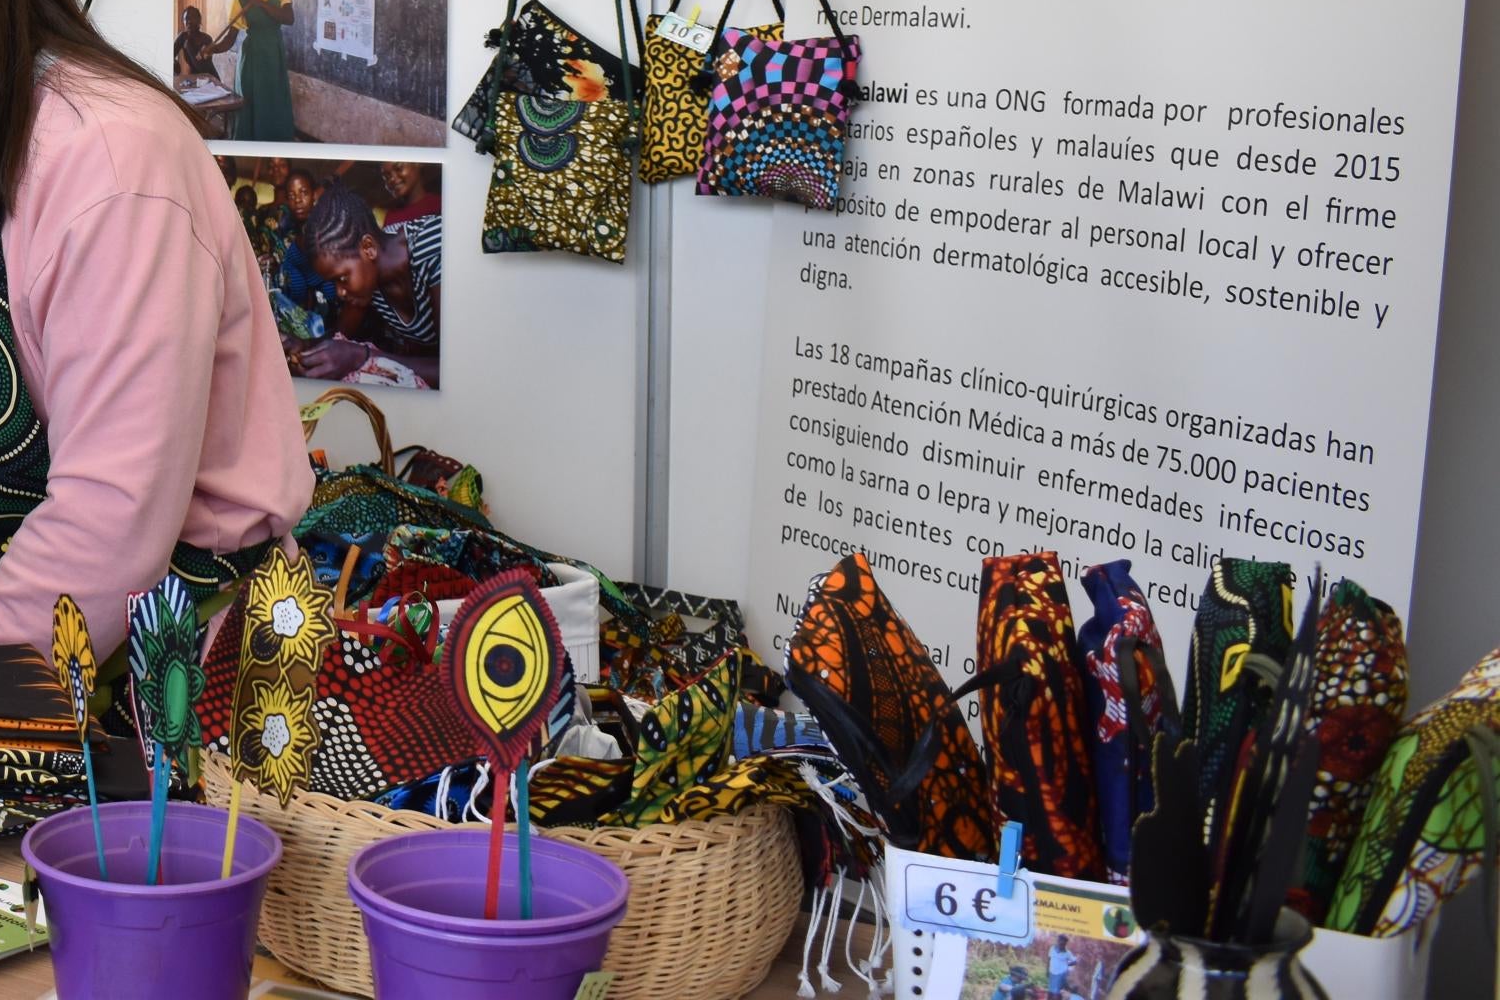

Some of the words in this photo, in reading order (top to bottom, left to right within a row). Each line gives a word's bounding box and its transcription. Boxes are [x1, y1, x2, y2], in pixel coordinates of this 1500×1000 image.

[668, 23, 690, 39] 10
[692, 33, 706, 45] €
[862, 5, 970, 29] Dermalawi.
[916, 89, 938, 106] es
[947, 91, 986, 109] una
[996, 89, 1046, 112] ONG
[1063, 91, 1154, 119] formada
[1164, 103, 1207, 126] por
[1228, 102, 1404, 135] profesionales
[907, 125, 1018, 151] españoles
[1031, 136, 1043, 159] y
[1057, 134, 1155, 162] malauíes
[1171, 147, 1219, 171] que
[1237, 145, 1316, 175] desde
[1334, 153, 1400, 182] 2015
[878, 164, 900, 181] en
[913, 167, 975, 188] zonas
[990, 171, 1064, 196] rurales
[1078, 175, 1104, 200] de
[1119, 180, 1204, 210] Malawi
[1222, 195, 1267, 216] con
[1286, 195, 1308, 220] el
[1326, 197, 1396, 229] firme
[895, 198, 919, 222] de
[930, 208, 1052, 238] empoderar
[1061, 216, 1079, 240] al
[1090, 225, 1185, 252] personal
[1199, 230, 1258, 261] local
[1271, 245, 1285, 269] y
[1298, 242, 1393, 275] ofrecer
[800, 262, 852, 290] digna.
[803, 231, 835, 249] una
[845, 234, 920, 261] atención
[933, 242, 1088, 284] dermatológica
[1101, 269, 1209, 304] accesible,
[1225, 285, 1359, 319] sostenible
[1375, 303, 1389, 329] y
[796, 336, 823, 360] Las
[830, 343, 850, 365] 18
[855, 353, 952, 385] campañas
[961, 366, 1157, 424] clínico-quirúrgicas
[1166, 410, 1315, 453] organizadas
[1327, 430, 1373, 465] han
[792, 378, 867, 408] prestado
[871, 390, 961, 427] Atención
[969, 408, 1044, 444] Médica
[1052, 430, 1063, 448] a
[1071, 432, 1115, 458] más
[1122, 438, 1149, 465] de
[1157, 445, 1236, 484] 75.000
[1244, 469, 1370, 512] pacientes
[787, 452, 835, 477] como
[841, 457, 854, 482] la
[859, 470, 909, 496] sarna
[917, 484, 930, 500] o
[938, 481, 990, 515] lepra
[998, 501, 1009, 524] y
[1016, 505, 1136, 550] mejorando
[1145, 529, 1162, 557] la
[790, 415, 908, 456] consiguiendo
[923, 440, 1025, 480] disminuir
[1037, 468, 1203, 522] enfermedades
[1220, 504, 1364, 559] infecciosas
[781, 525, 857, 558] precoces
[784, 483, 806, 507] de
[818, 490, 843, 517] los
[853, 506, 952, 546] pacientes
[966, 536, 1004, 557] con
[934, 882, 958, 917] 6
[972, 887, 997, 922] €
